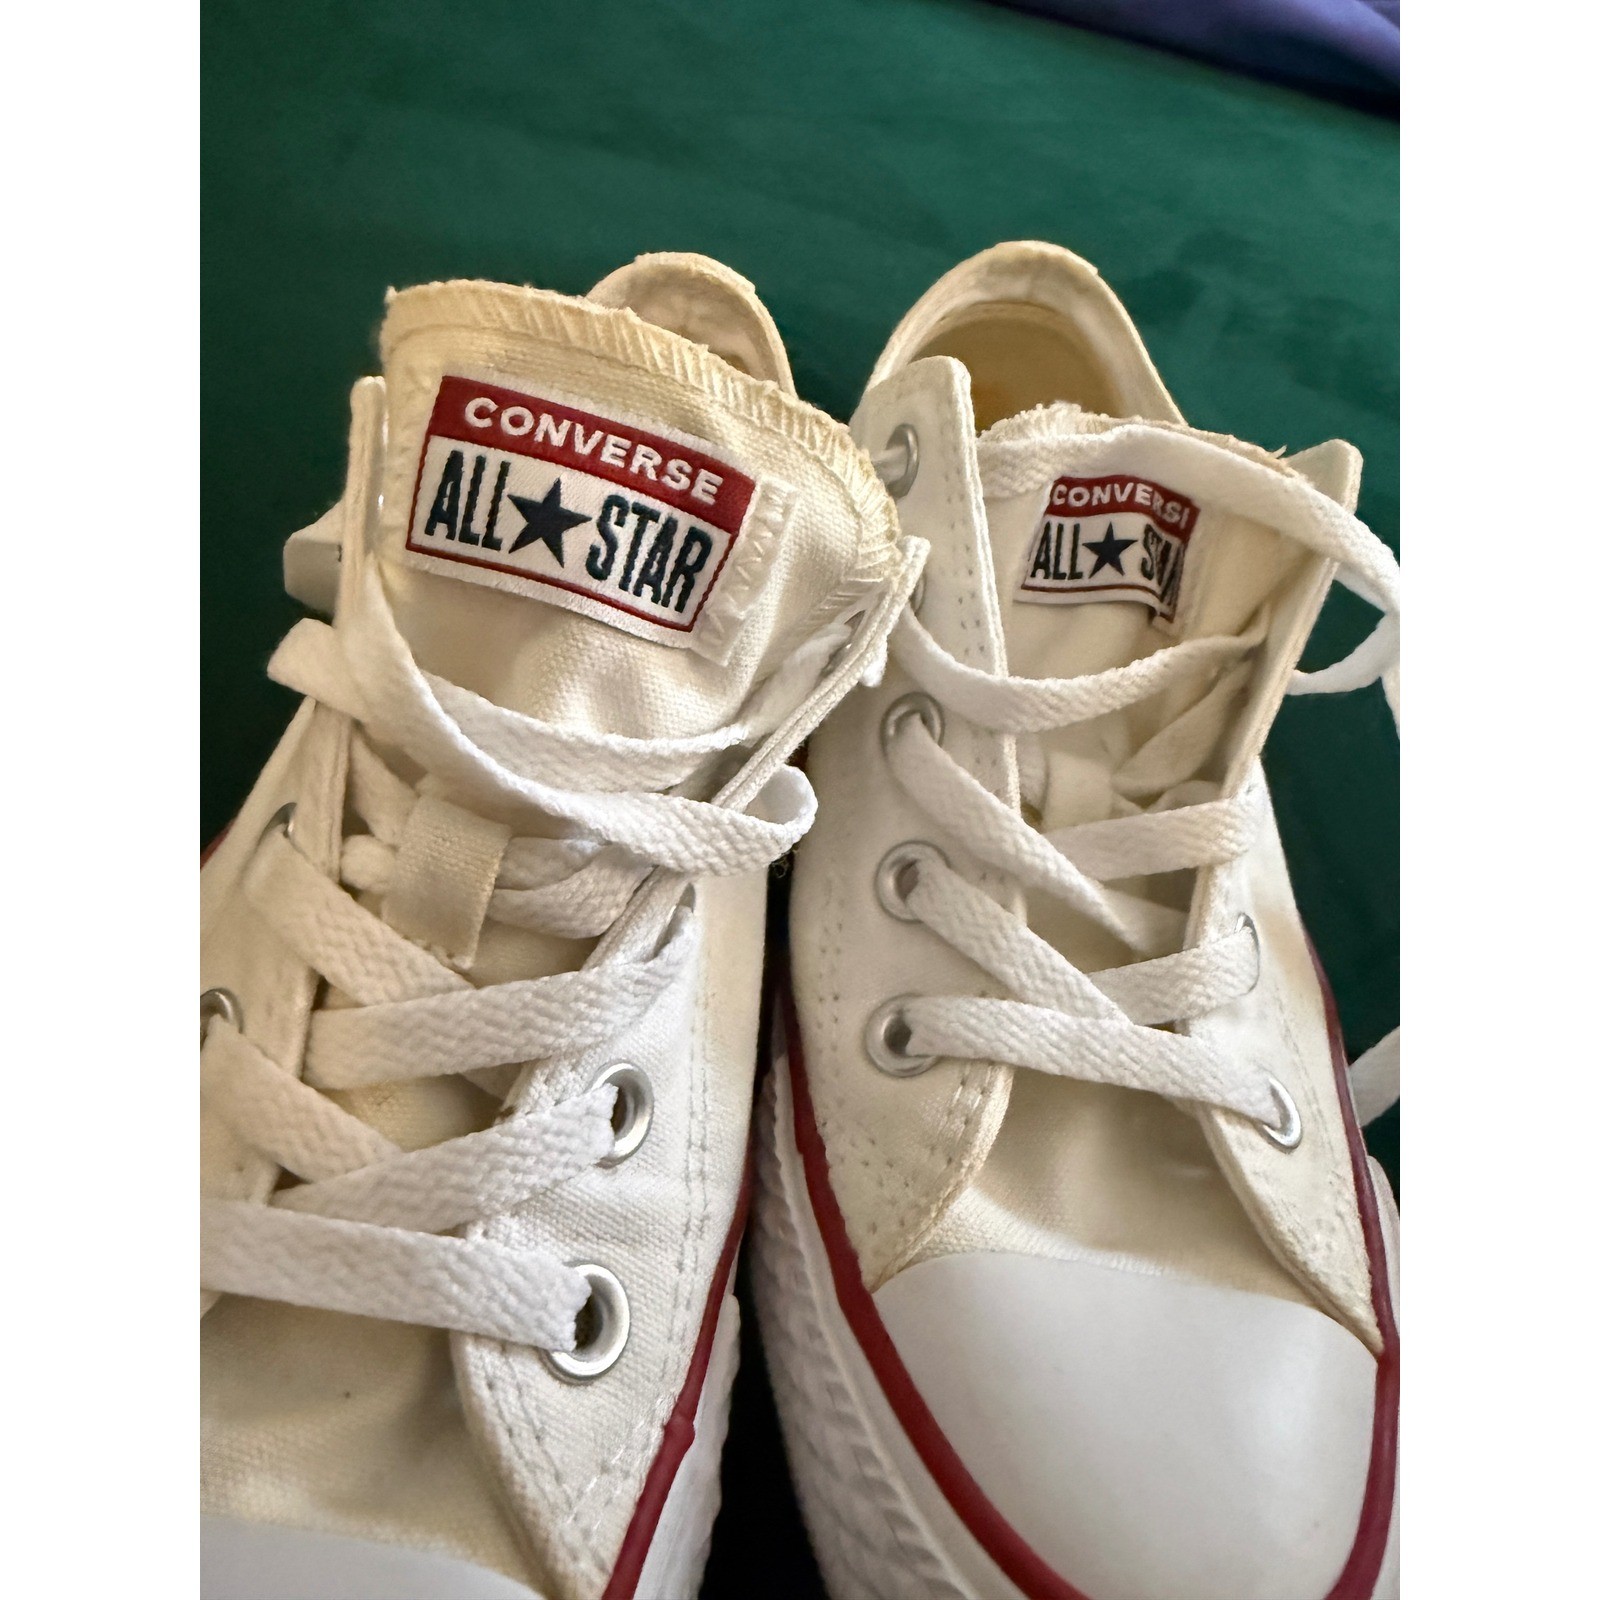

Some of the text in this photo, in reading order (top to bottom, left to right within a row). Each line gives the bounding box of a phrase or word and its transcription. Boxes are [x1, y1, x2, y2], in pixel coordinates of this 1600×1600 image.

[464, 396, 724, 506] CONVERSE
[424, 449, 713, 614] ALL STAR
[1030, 520, 1084, 581] ALL
